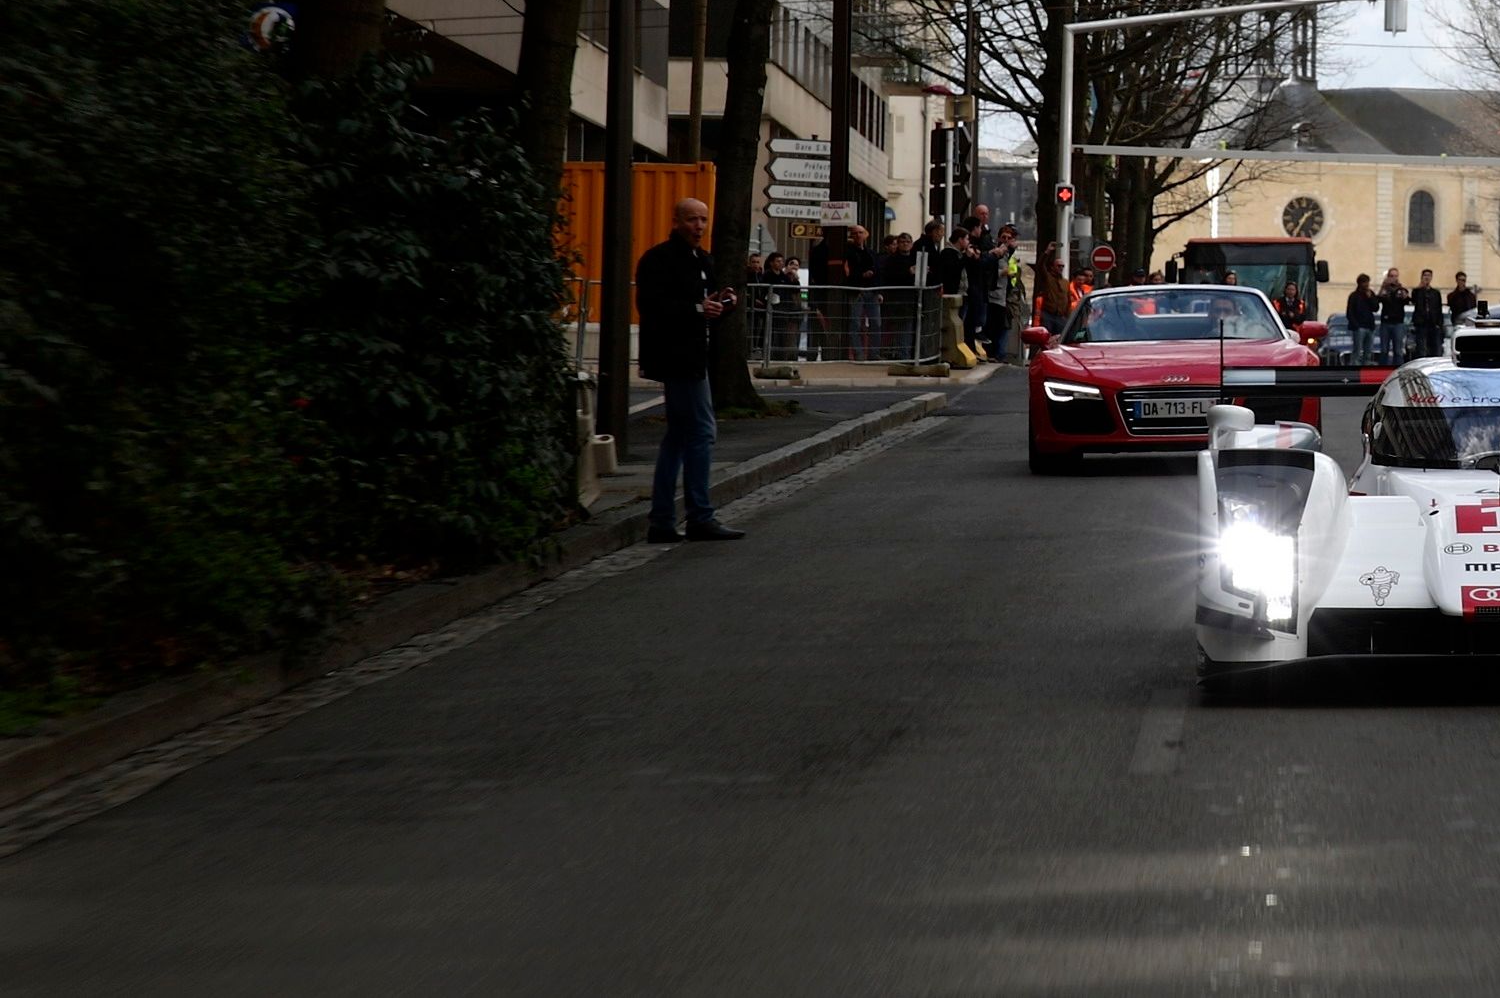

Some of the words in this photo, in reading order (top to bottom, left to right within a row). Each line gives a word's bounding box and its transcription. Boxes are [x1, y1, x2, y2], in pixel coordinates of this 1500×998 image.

[795, 143, 812, 151] Gare
[783, 170, 811, 179] Conseil
[783, 189, 801, 198] Lycée
[775, 206, 803, 216] Collège
[1407, 393, 1446, 404] Audi
[1143, 402, 1207, 416] DA-713-FL
